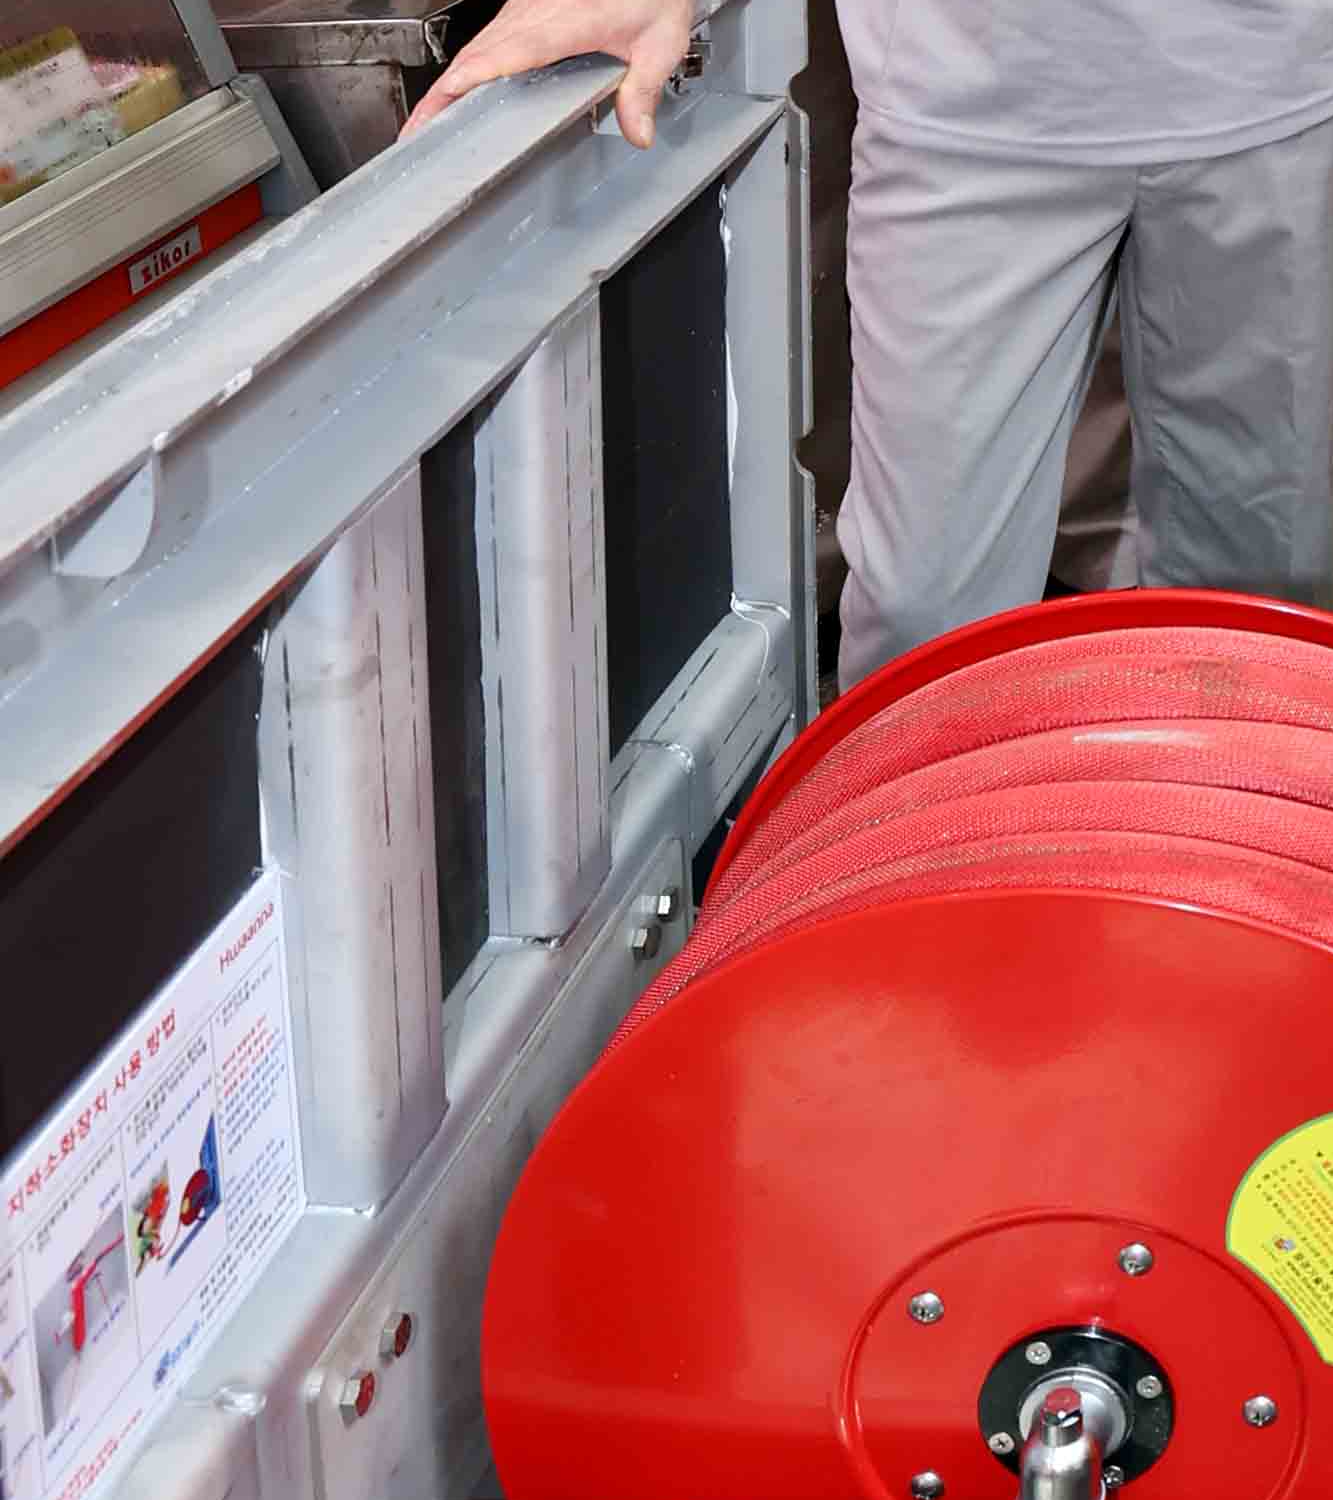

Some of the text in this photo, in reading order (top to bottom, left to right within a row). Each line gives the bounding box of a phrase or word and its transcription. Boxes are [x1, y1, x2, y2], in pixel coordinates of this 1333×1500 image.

[8, 1087, 108, 1220] 지하소화장치
[112, 1048, 142, 1097] 사용
[145, 1007, 177, 1057] 방법
